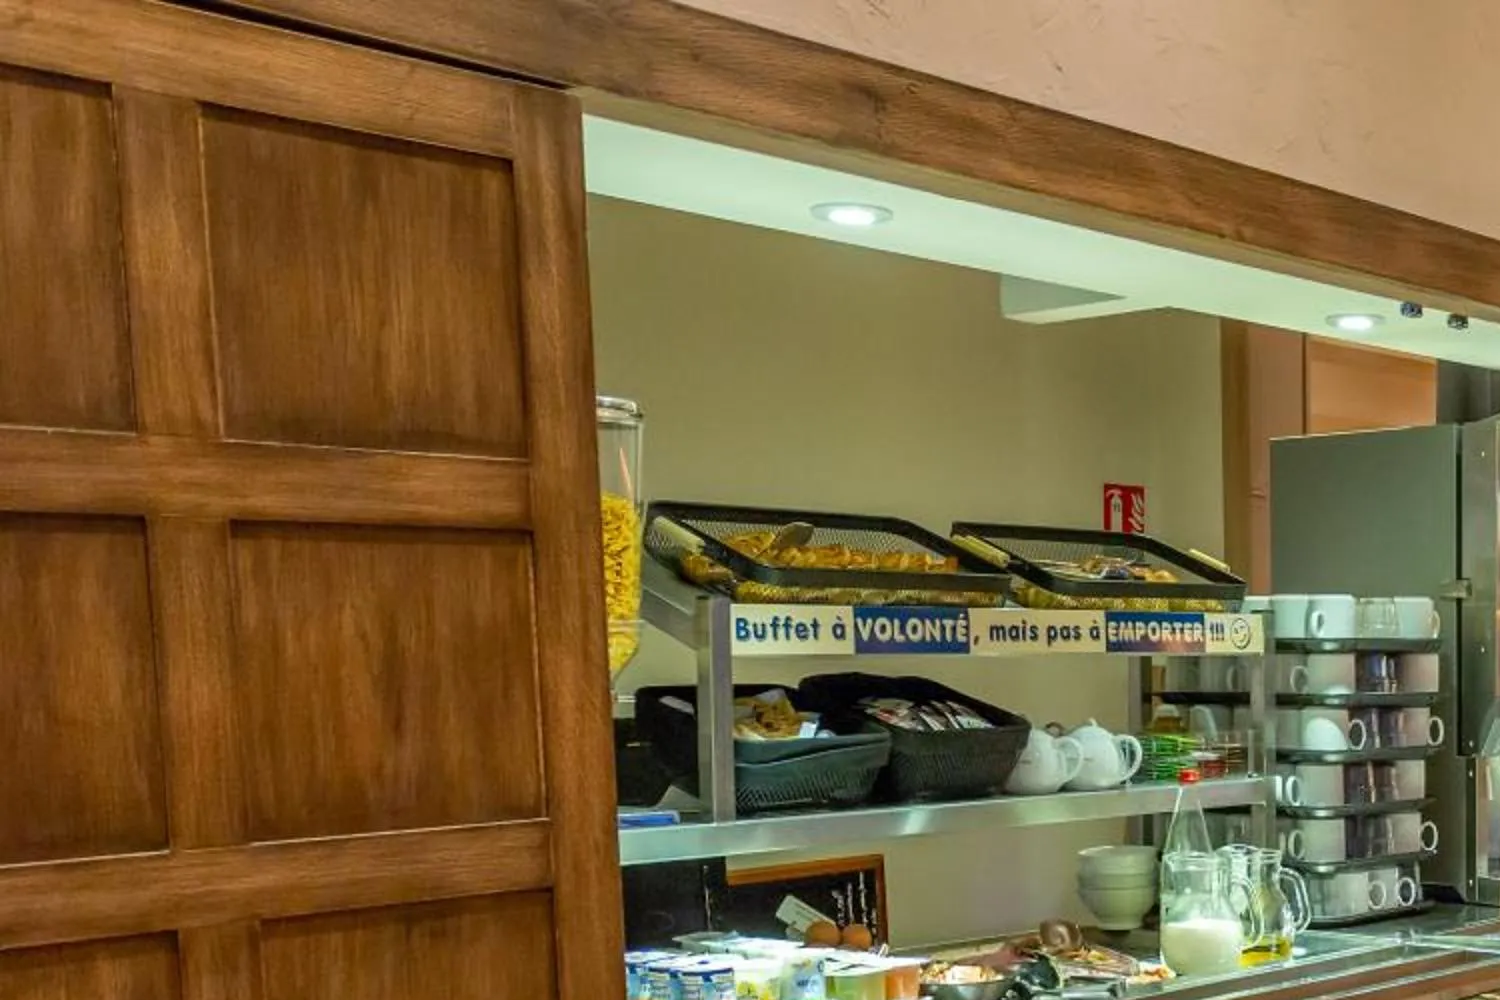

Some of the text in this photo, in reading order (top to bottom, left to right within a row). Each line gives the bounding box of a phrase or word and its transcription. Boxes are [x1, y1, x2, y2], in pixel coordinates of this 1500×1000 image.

[734, 615, 820, 642] Buffet
[831, 615, 848, 641] à
[989, 619, 1040, 642] mais
[1046, 623, 1082, 646] pas
[1089, 619, 1101, 642] à
[1107, 620, 1205, 644] EMPORTER
